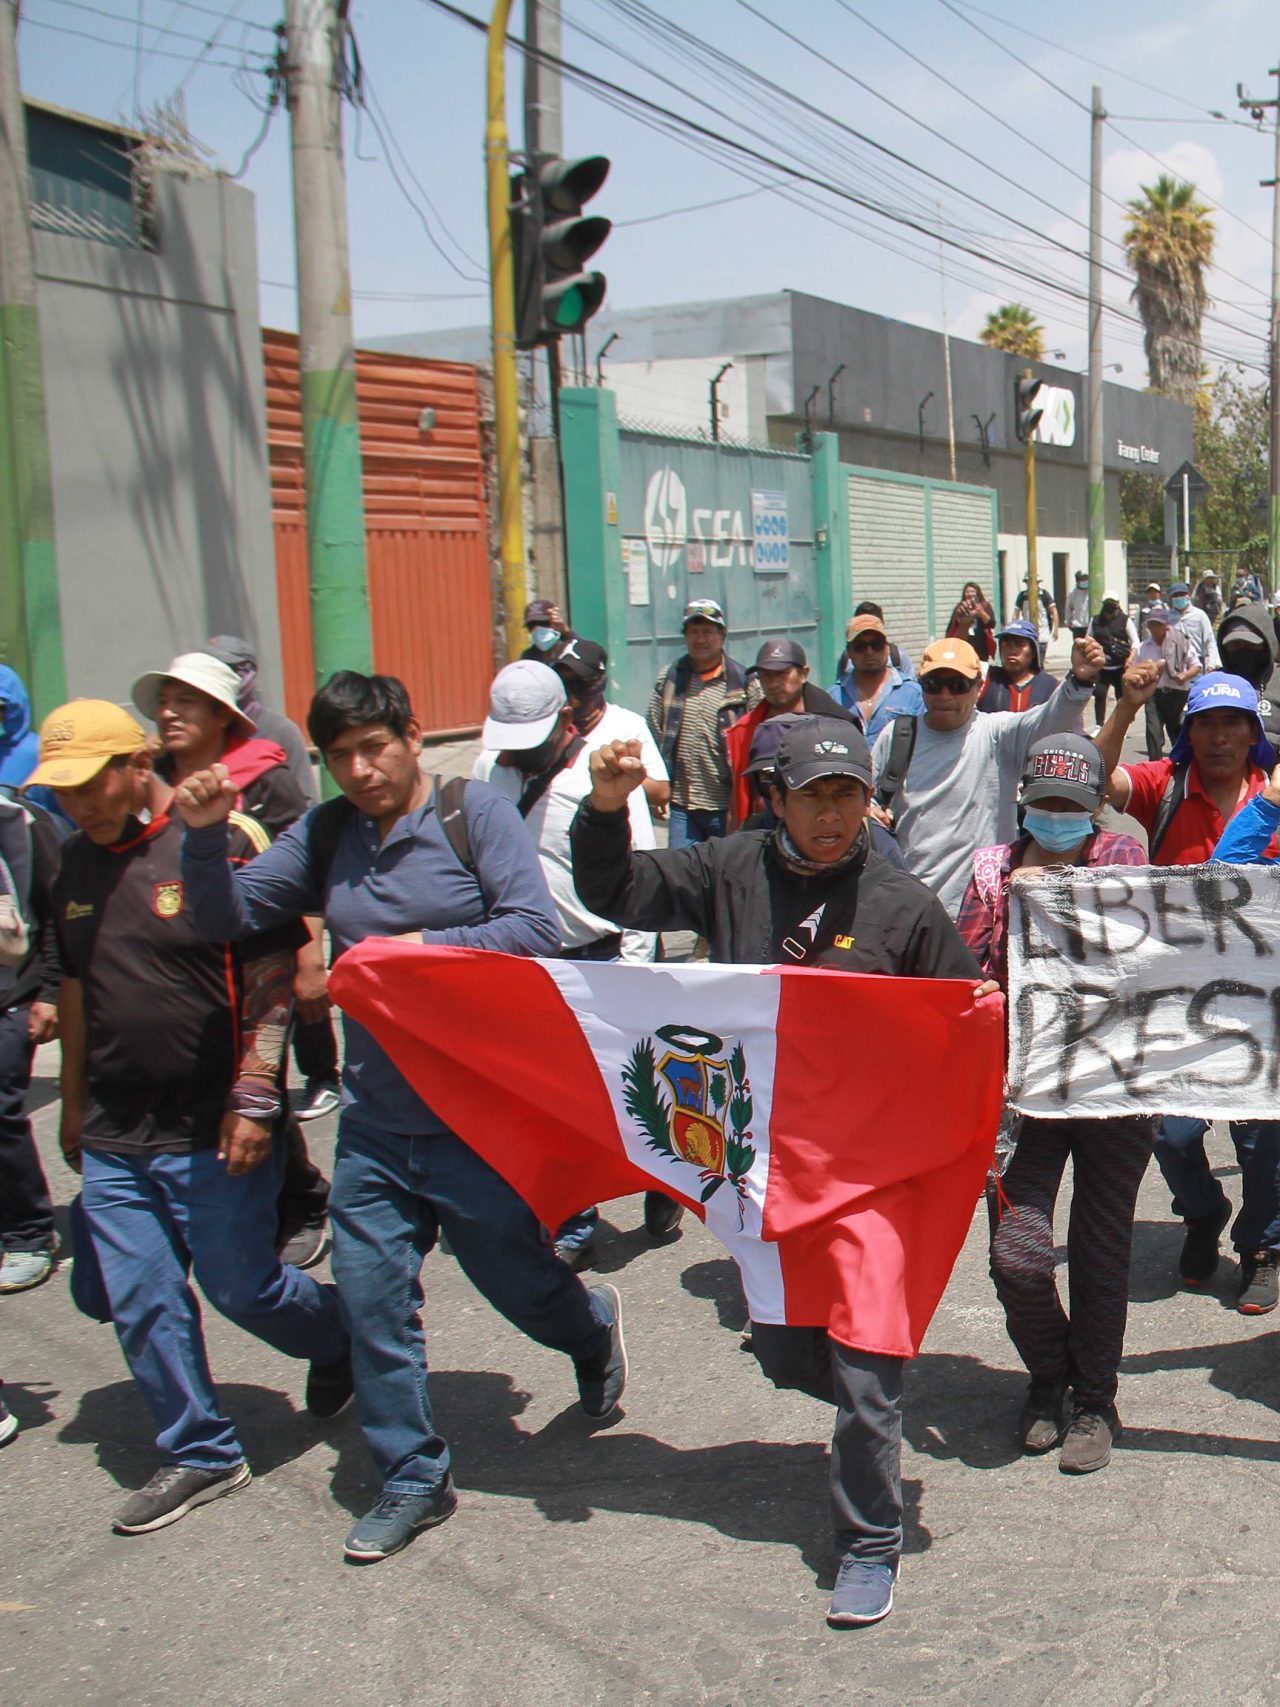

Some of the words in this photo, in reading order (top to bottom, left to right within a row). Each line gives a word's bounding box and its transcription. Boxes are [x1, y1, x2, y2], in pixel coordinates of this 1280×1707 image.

[693, 509, 754, 568] SEA
[1202, 686, 1241, 699] YURA
[1044, 749, 1084, 760] CHICAGO
[1033, 754, 1090, 784] BULLS
[834, 934, 856, 949] CAT
